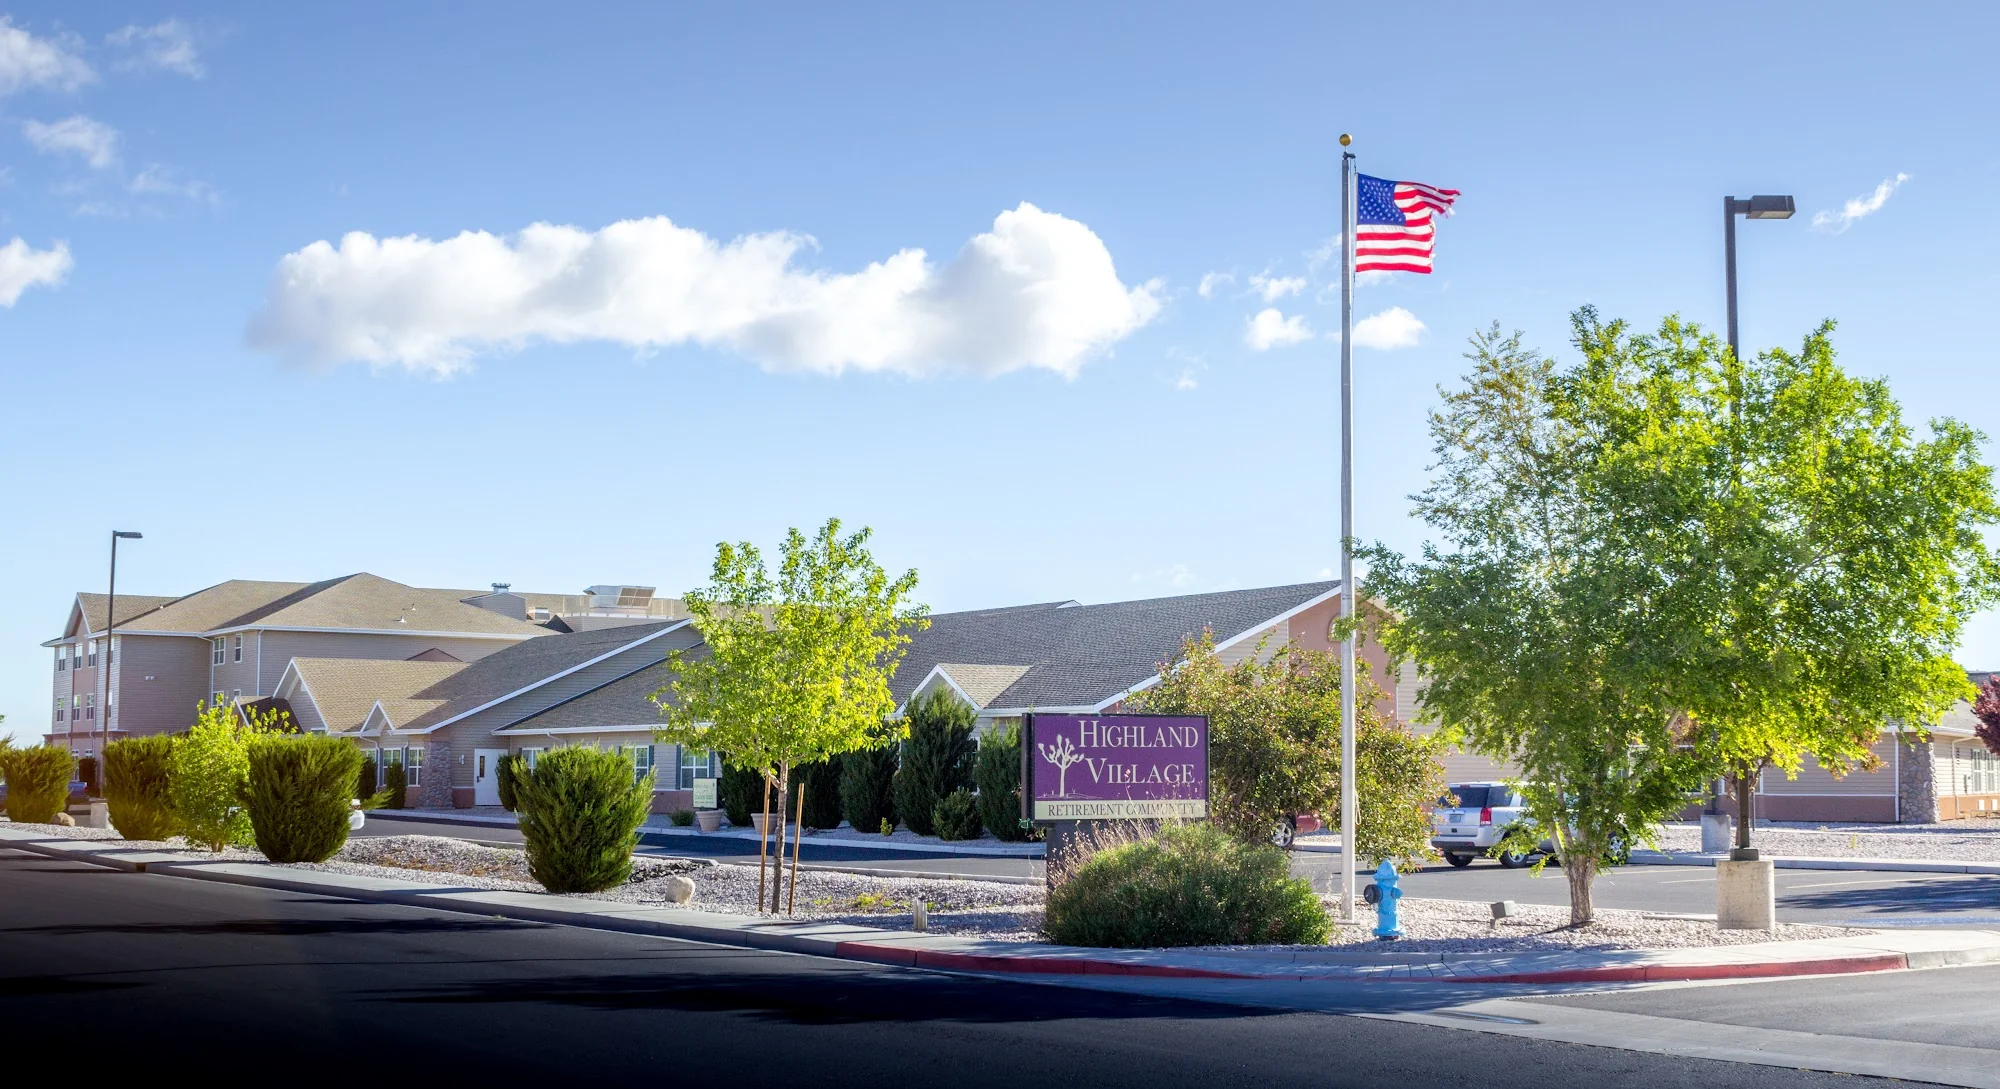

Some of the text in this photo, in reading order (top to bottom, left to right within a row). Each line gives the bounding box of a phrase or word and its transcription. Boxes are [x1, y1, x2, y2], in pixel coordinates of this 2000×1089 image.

[1078, 720, 1199, 748] HIGHLAND
[1085, 757, 1196, 784] VILLAGE
[1048, 803, 1196, 817] RETIREMENT COMMUNITY
